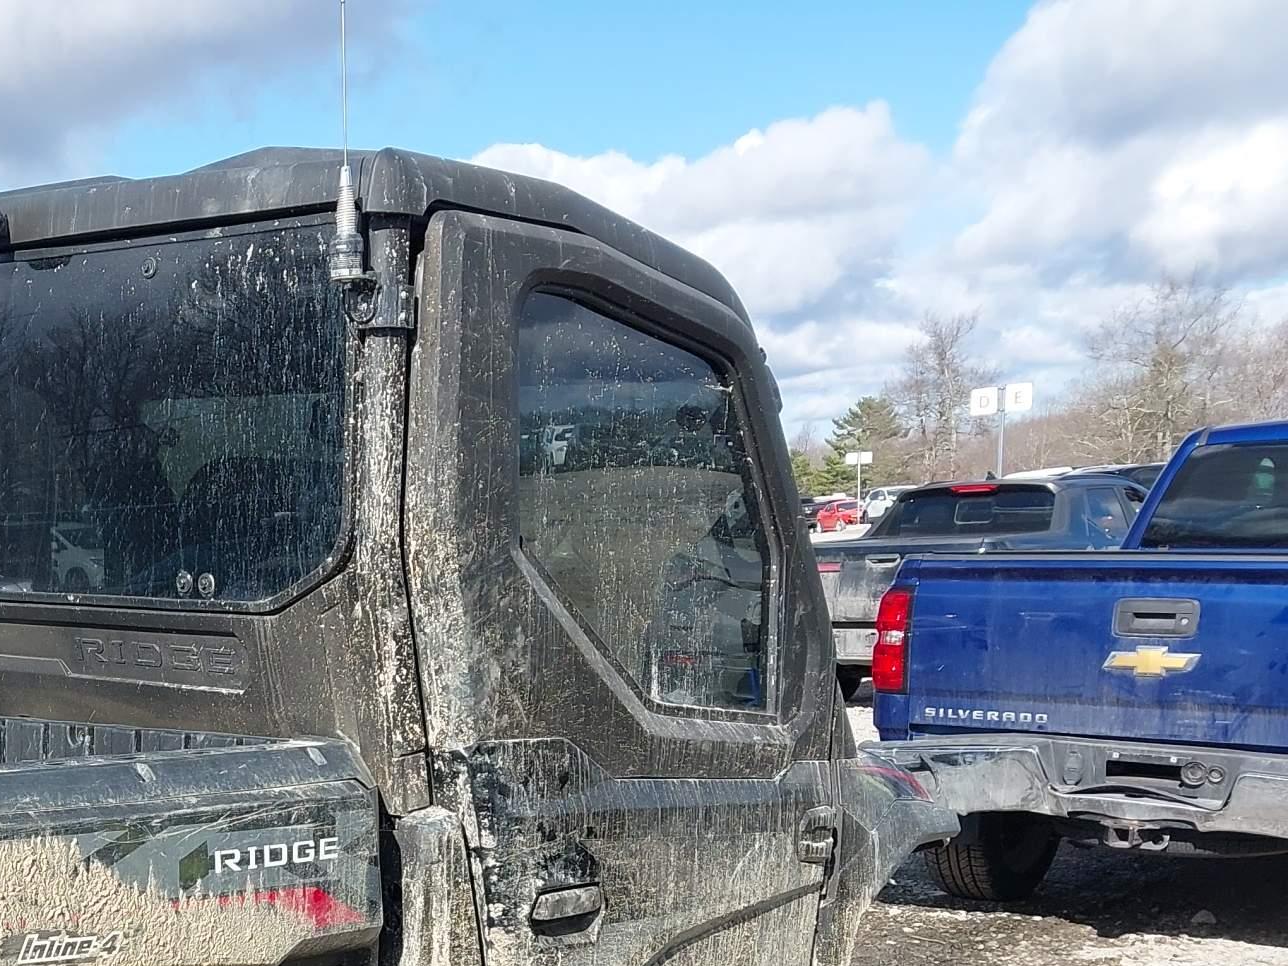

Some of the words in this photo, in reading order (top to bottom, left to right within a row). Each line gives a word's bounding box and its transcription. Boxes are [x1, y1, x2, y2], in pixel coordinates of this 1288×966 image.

[979, 395, 990, 409] D
[1014, 390, 1025, 404] E
[74, 637, 236, 675] RIDGE
[924, 707, 1049, 724] SILVERADO
[214, 837, 339, 874] RIDGE
